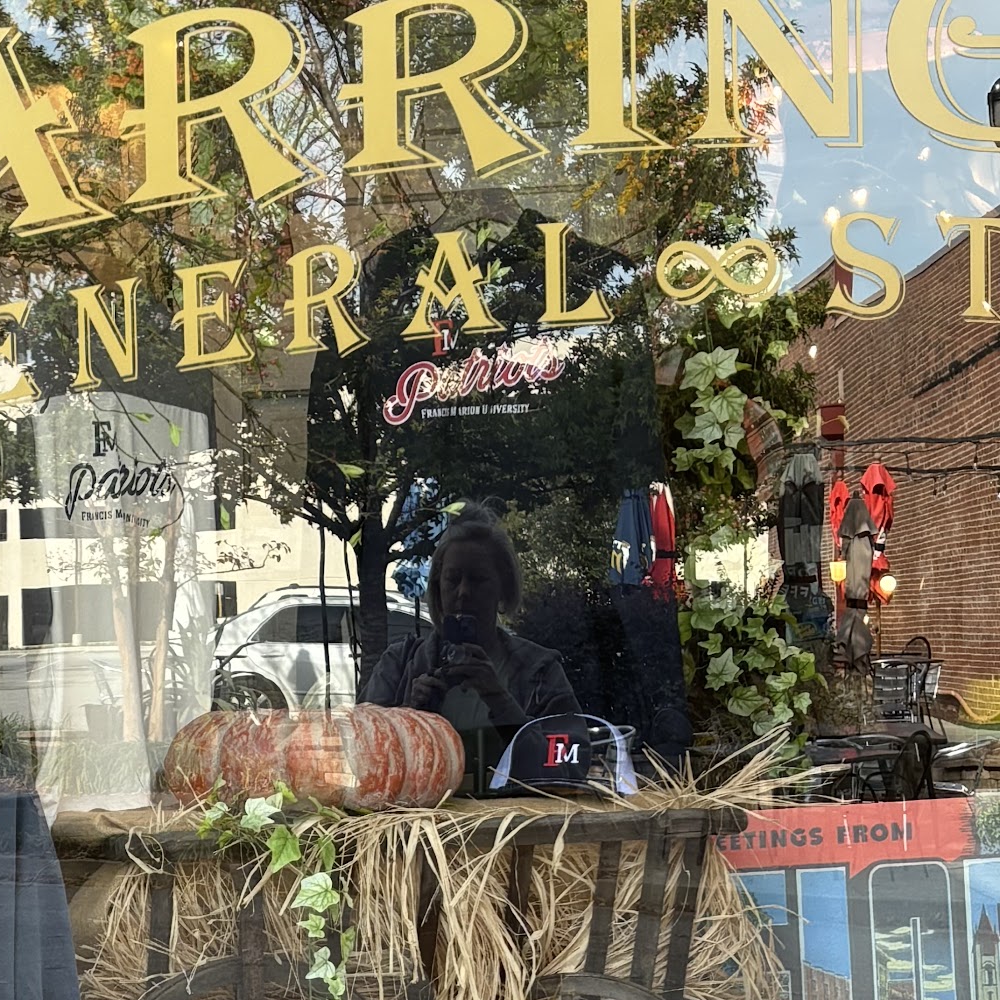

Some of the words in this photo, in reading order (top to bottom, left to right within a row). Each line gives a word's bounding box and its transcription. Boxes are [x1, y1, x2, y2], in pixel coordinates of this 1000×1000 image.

[543, 734, 580, 767] FM
[716, 827, 824, 851] EETINGS
[837, 822, 912, 845] FROM
